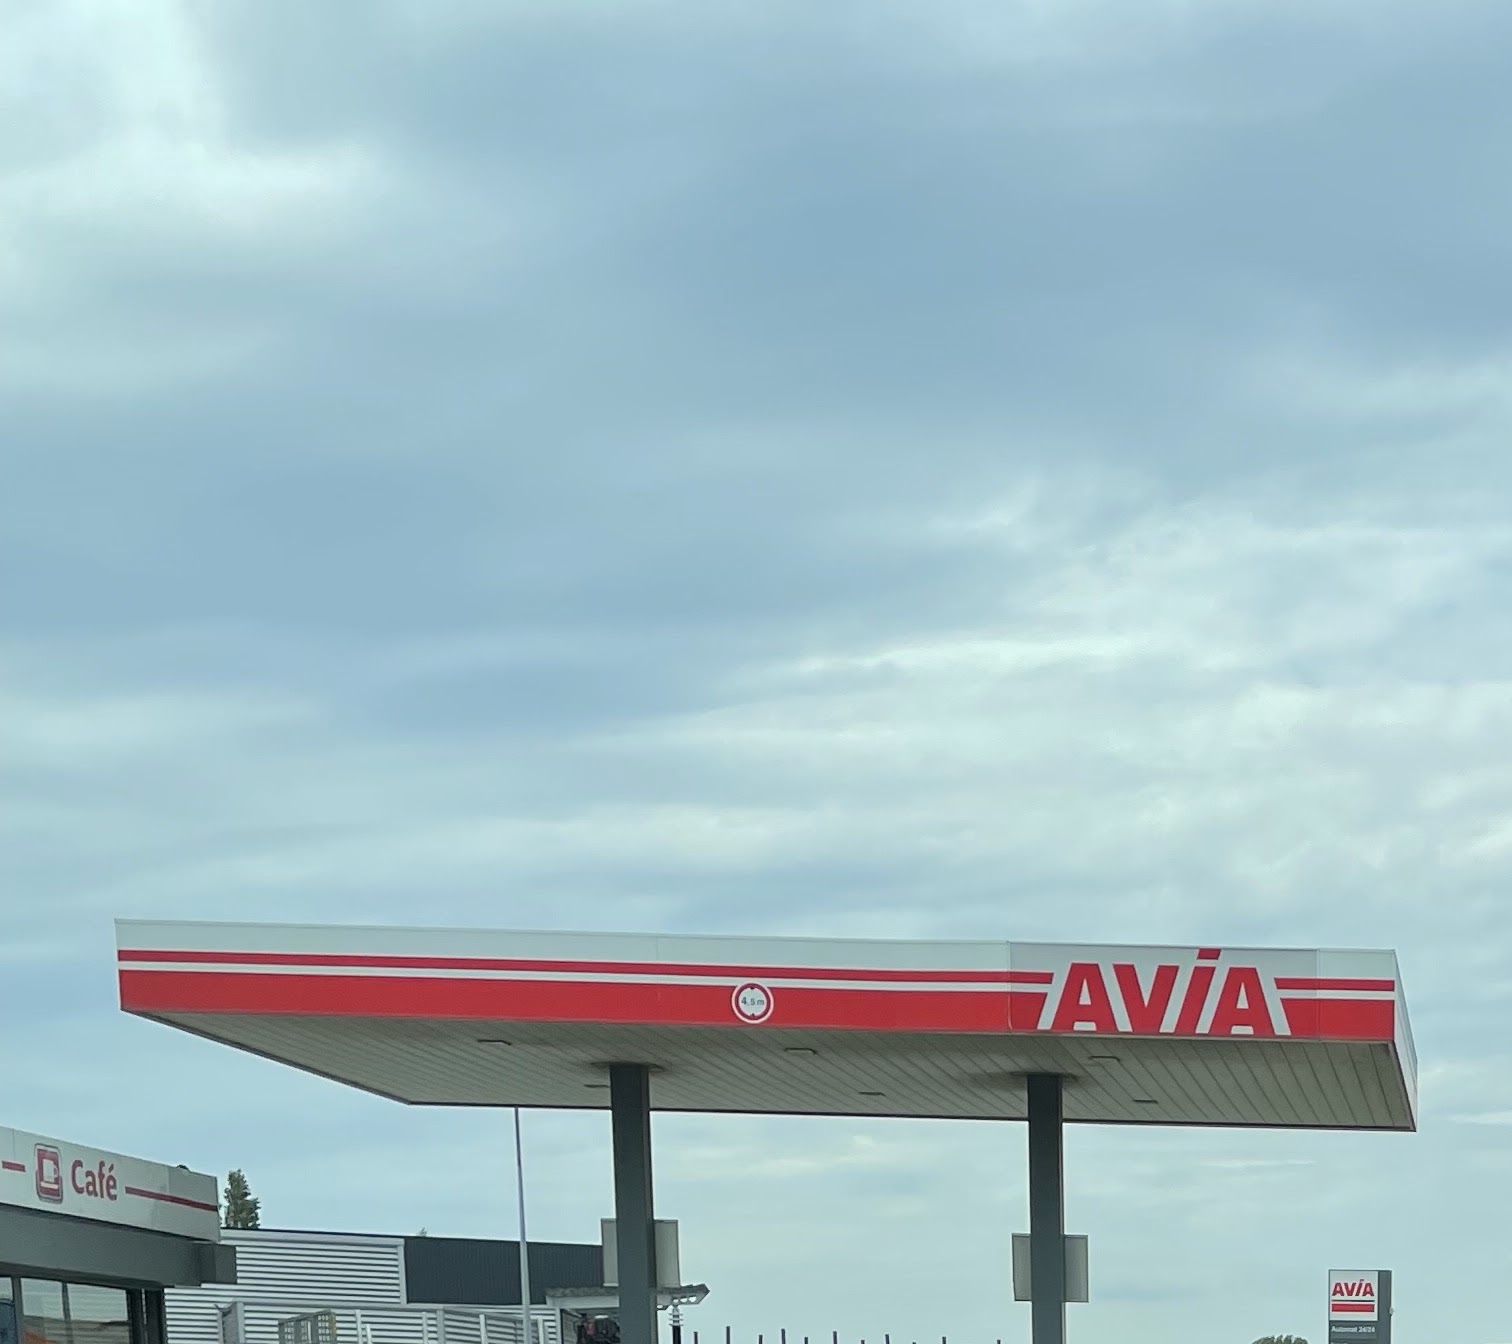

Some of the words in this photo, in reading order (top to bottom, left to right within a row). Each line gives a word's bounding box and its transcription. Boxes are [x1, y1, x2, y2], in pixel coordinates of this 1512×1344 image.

[1050, 948, 1277, 1037] AVIA
[71, 1159, 118, 1201] Café
[1331, 1278, 1375, 1297] AVIA
